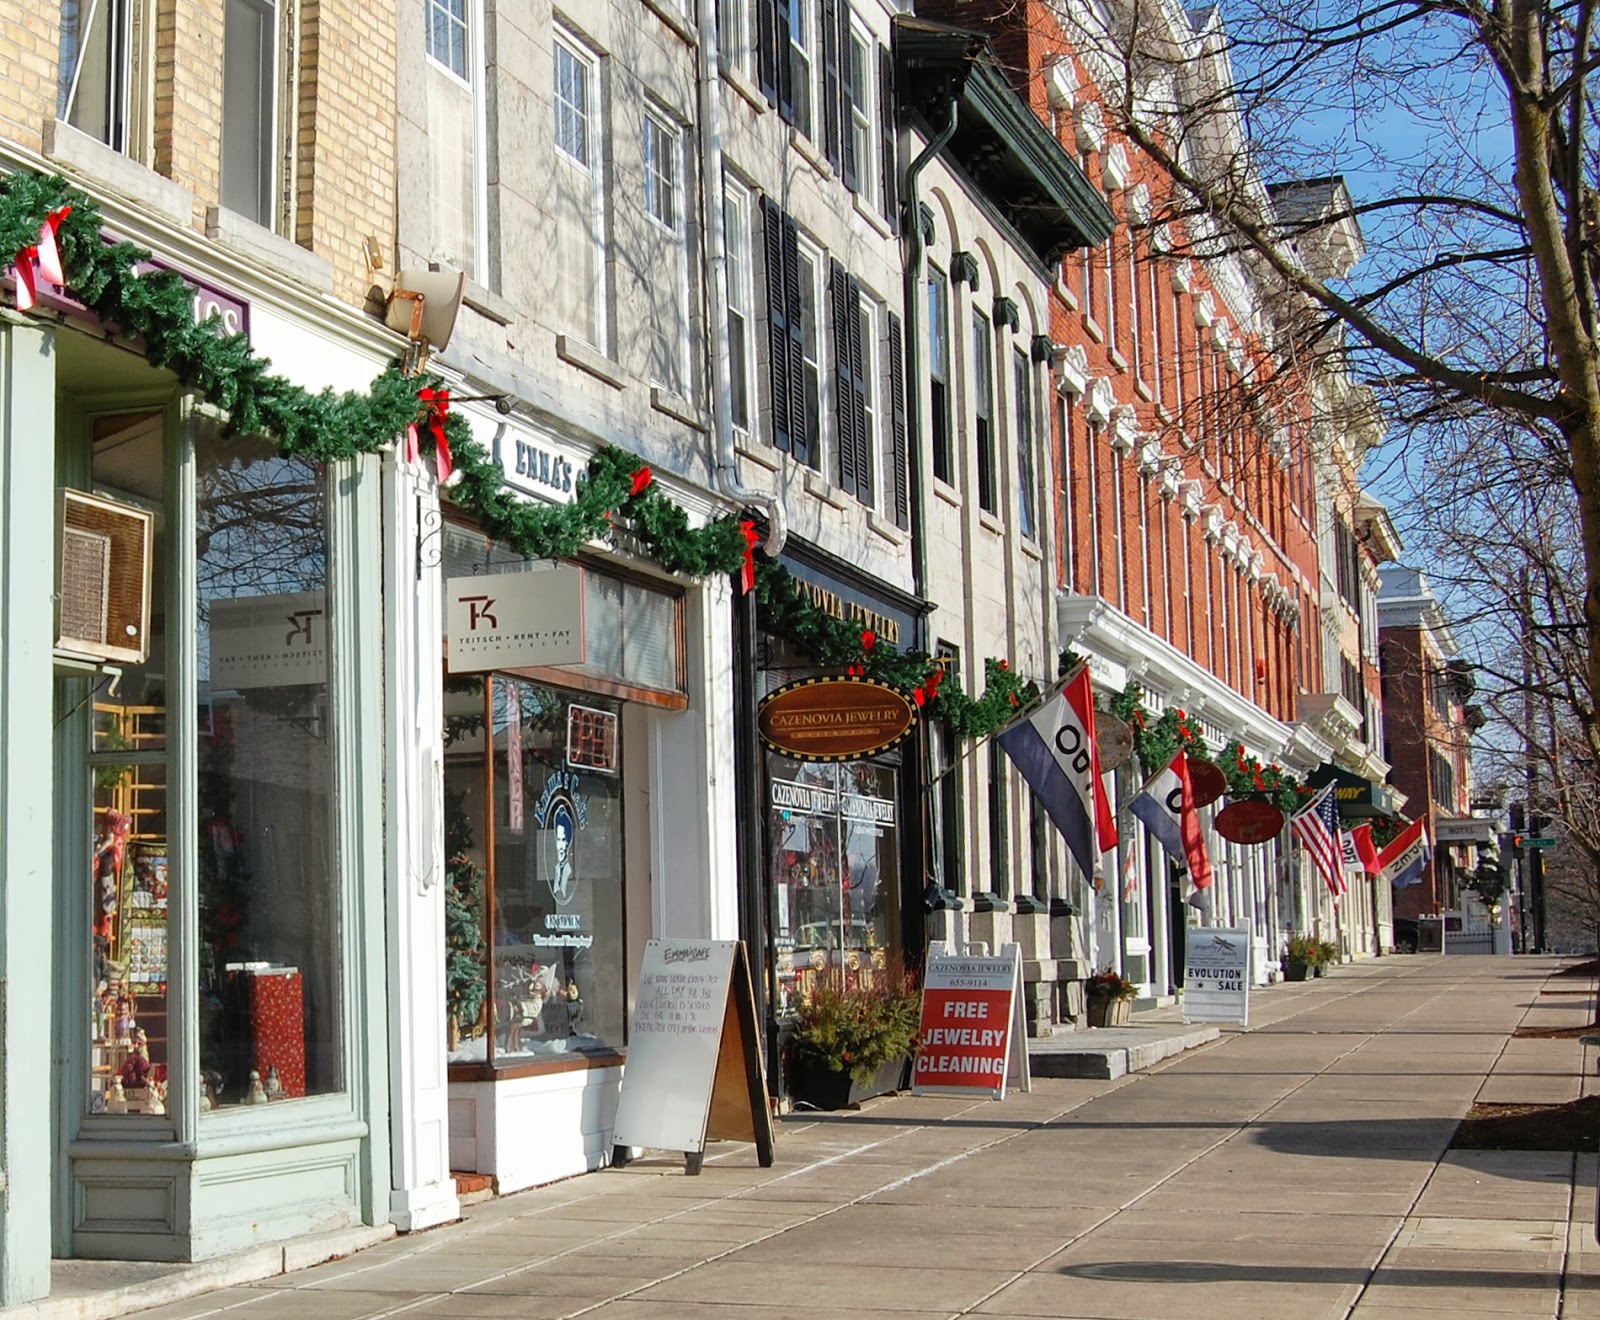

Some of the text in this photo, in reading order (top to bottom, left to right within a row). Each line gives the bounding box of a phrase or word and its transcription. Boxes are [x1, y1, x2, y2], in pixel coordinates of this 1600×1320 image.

[516, 440, 572, 493] EMMA'S
[789, 573, 843, 621] ENOVIA
[460, 630, 571, 644] TEITSCH KENT FAY
[460, 640, 570, 652] ARCHITECTS
[770, 709, 899, 726] CAZENOVIA JEWELRY
[772, 783, 810, 809] CAZENOVIA
[1334, 787, 1366, 799] WAY
[928, 964, 1012, 973] CAZENOVIA JEWELRY
[1188, 968, 1241, 979] EVOLUTION
[949, 979, 988, 987] 655-9114
[1218, 981, 1243, 991] SALE
[943, 1001, 988, 1018] FREE
[922, 1028, 1005, 1046] JEWELRY
[917, 1055, 1004, 1075] CLEANING
